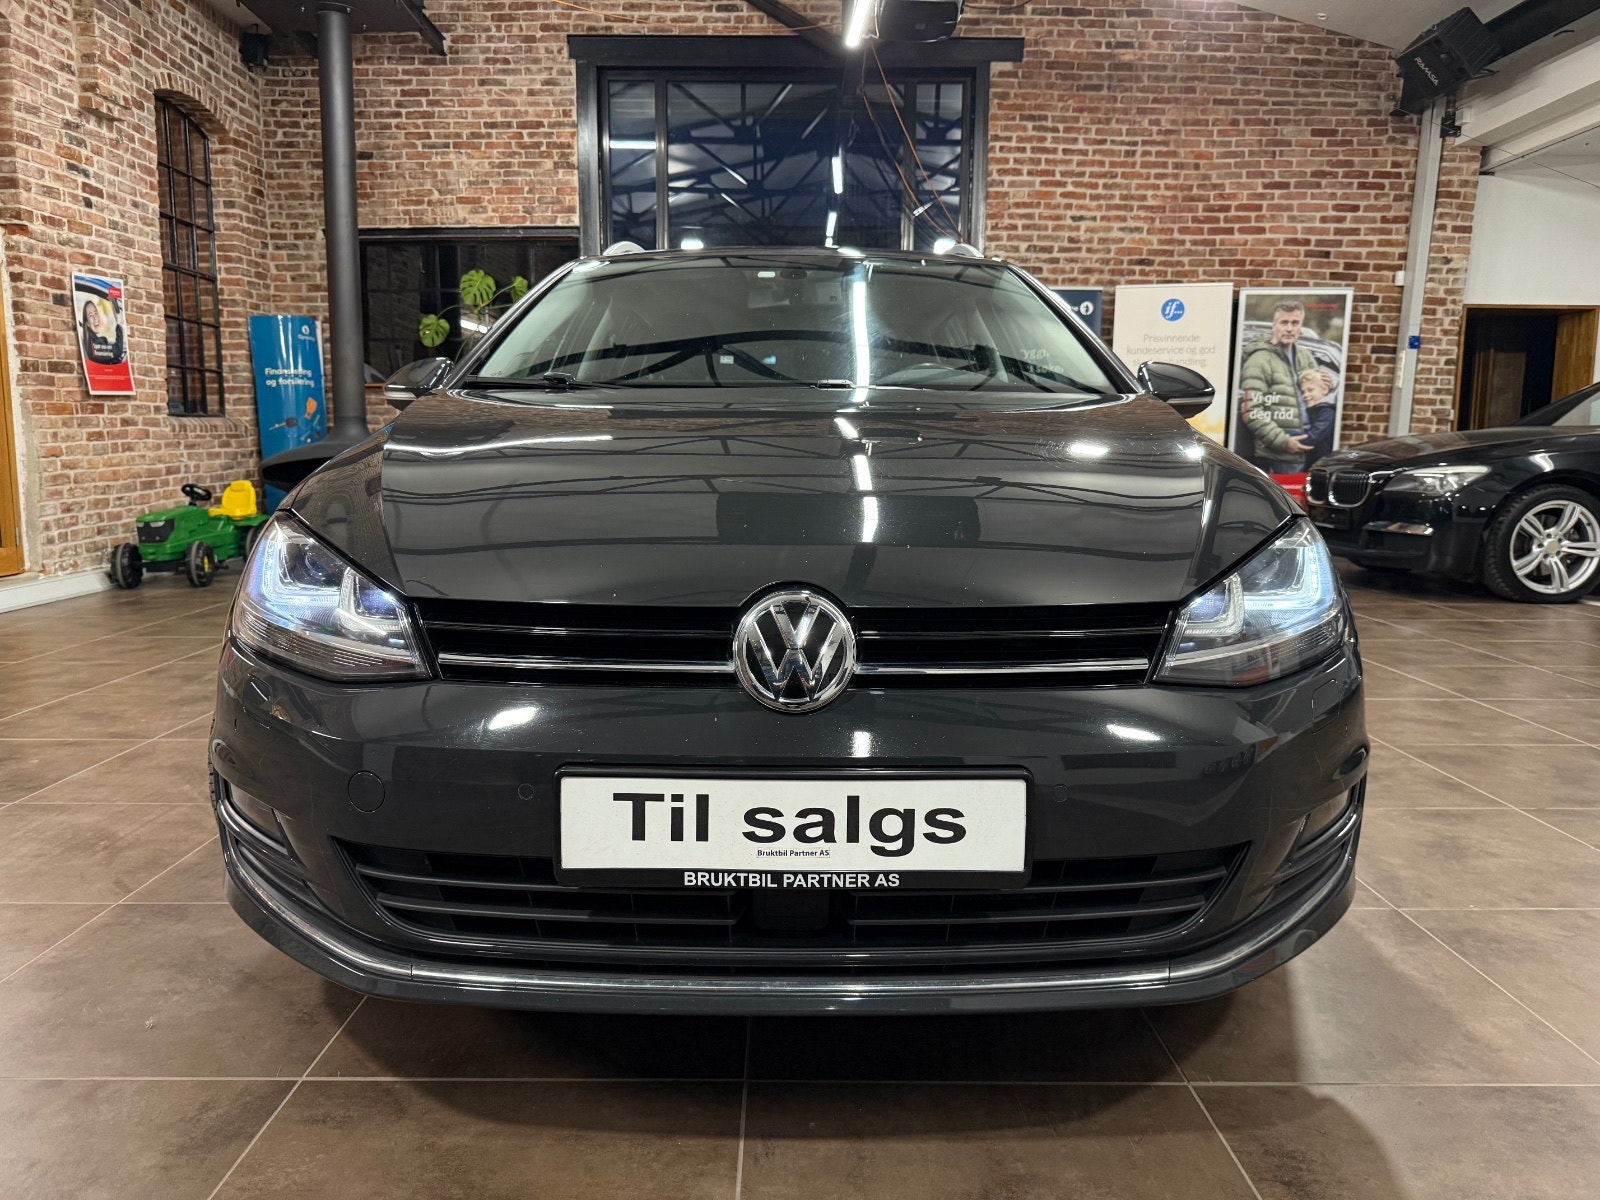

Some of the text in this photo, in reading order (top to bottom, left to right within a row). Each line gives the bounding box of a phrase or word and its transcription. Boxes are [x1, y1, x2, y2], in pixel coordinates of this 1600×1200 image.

[1143, 334, 1200, 343] Prisvinnende
[1126, 345, 1216, 356] kundeservice og god
[266, 379, 277, 388] og
[1251, 391, 1280, 406] Vi gir
[1249, 408, 1293, 422] deg råd
[613, 792, 967, 857] Til salgs
[757, 849, 830, 857] Bruktbil Partner AS
[684, 871, 900, 888] BRUKTBIL PARTNER AS
